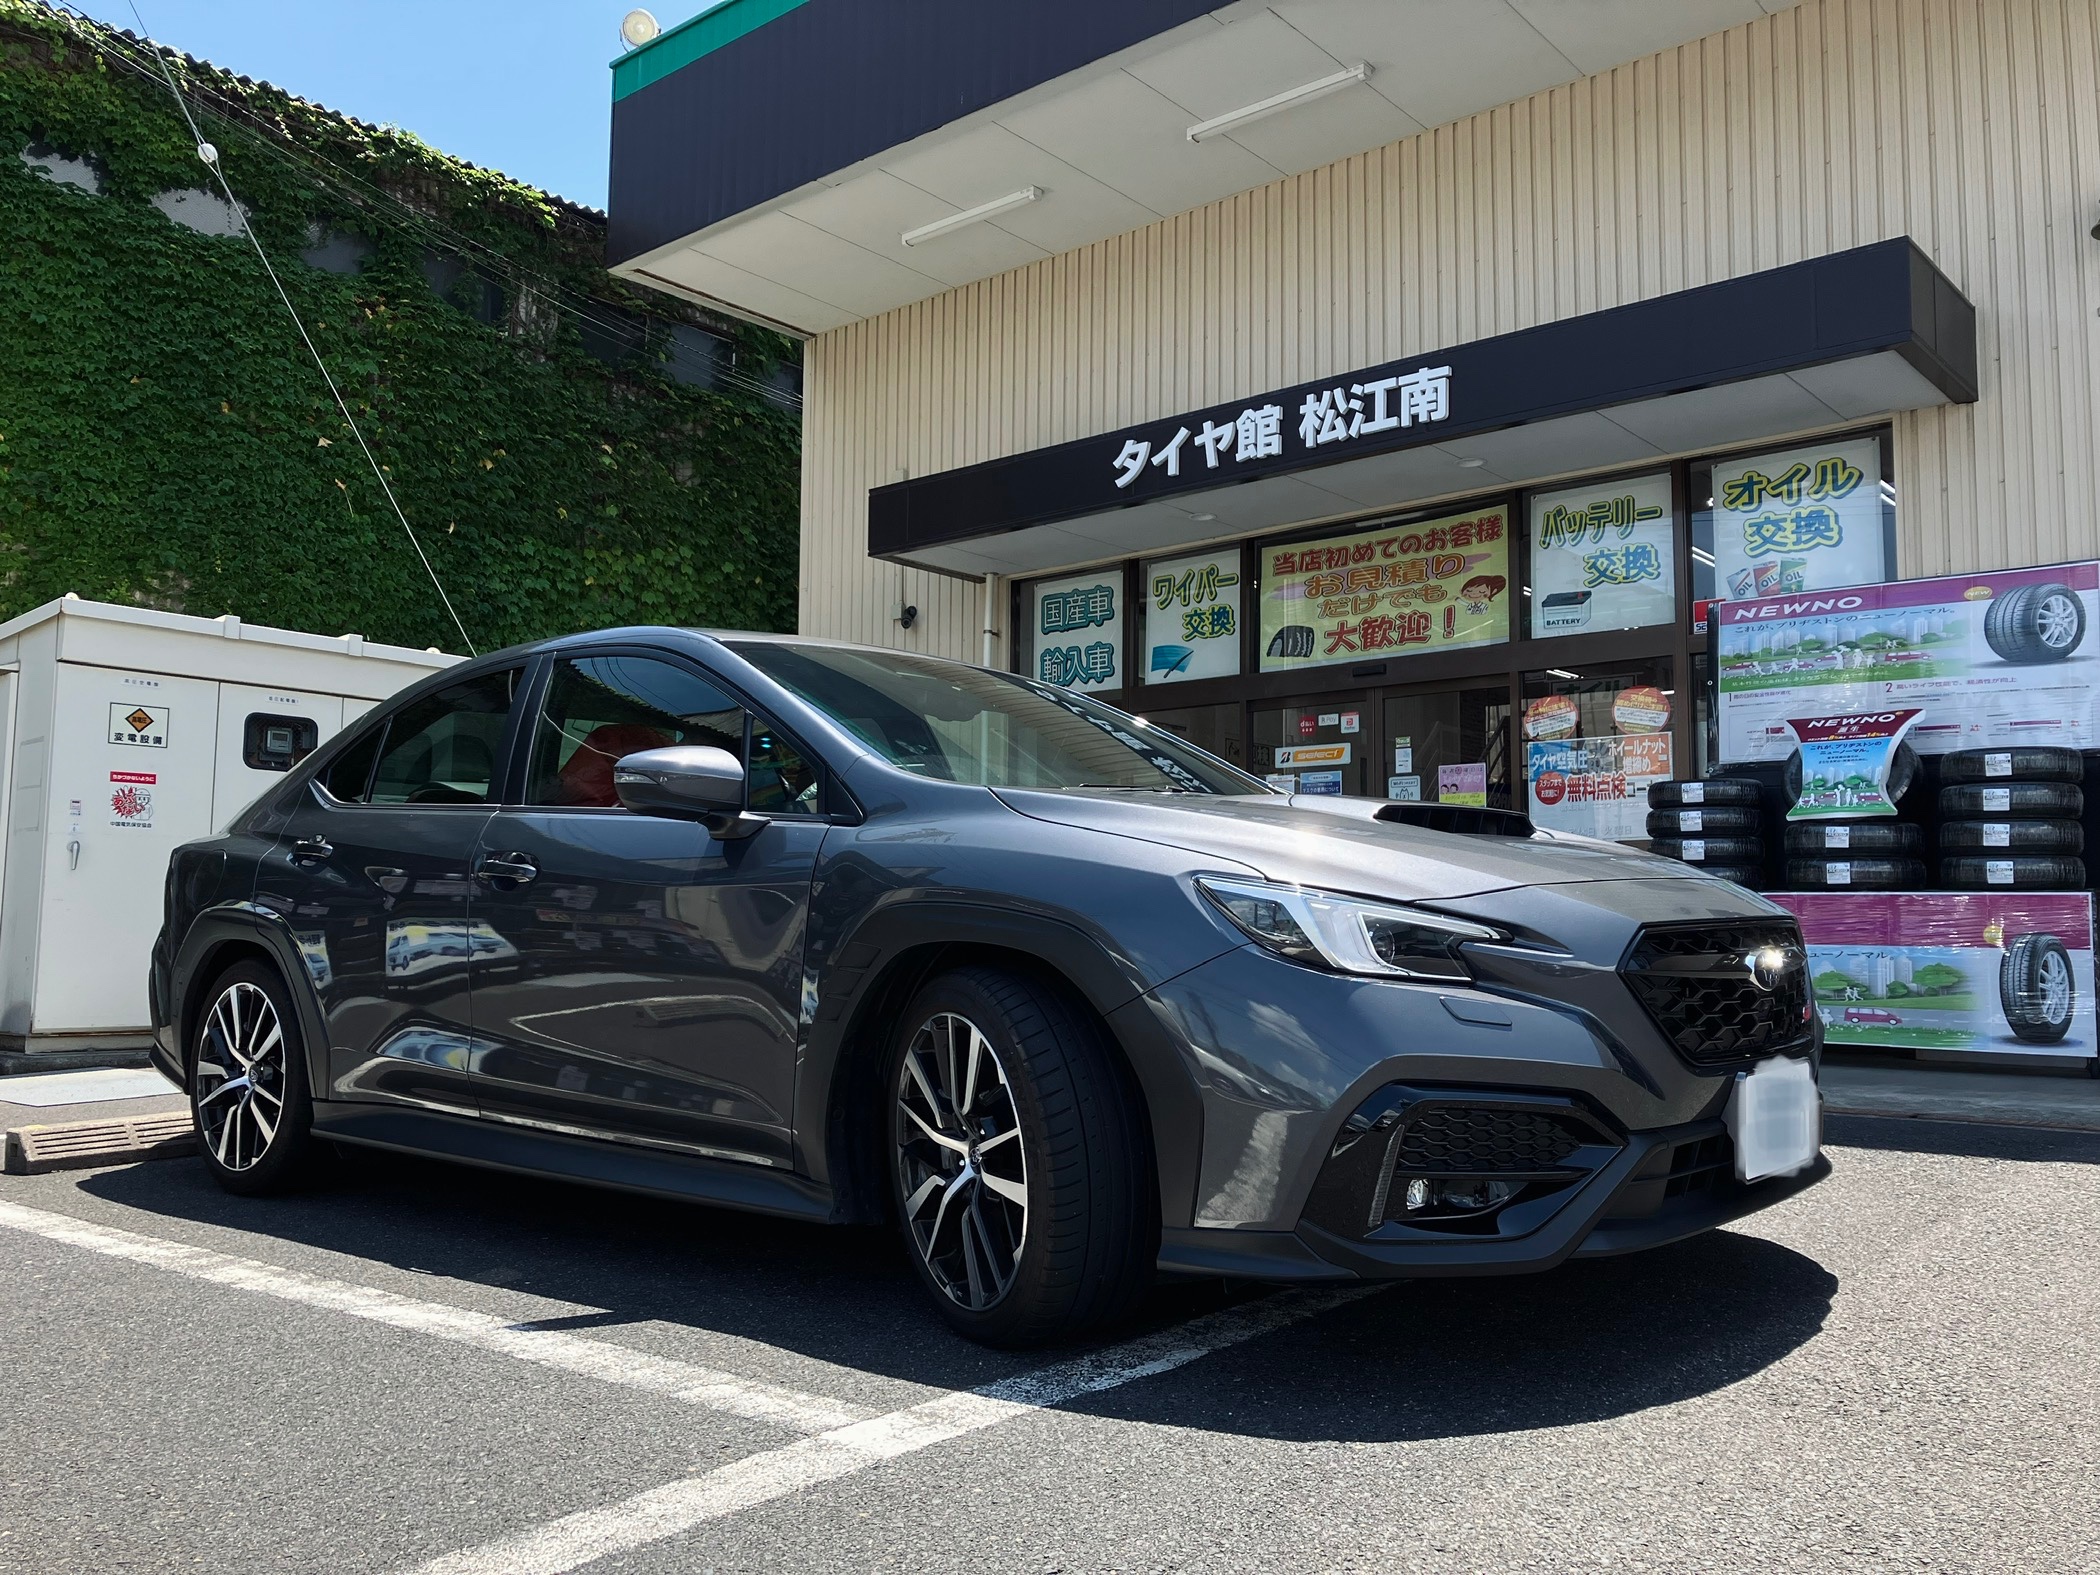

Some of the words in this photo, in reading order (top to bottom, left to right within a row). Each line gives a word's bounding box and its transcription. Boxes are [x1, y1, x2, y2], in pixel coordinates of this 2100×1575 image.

[1112, 404, 1283, 488] タイヤ館
[1299, 366, 1453, 448] 松江南
[1724, 457, 1863, 510] オイル
[1539, 496, 1662, 549] バッテリー
[1744, 505, 1843, 557] 交換
[1272, 514, 1504, 577] 当店初めてのお客様
[1304, 554, 1466, 597] お見積り
[1583, 544, 1660, 587] 交換
[1761, 575, 1777, 588] OIL
[1786, 571, 1804, 582] OIL
[1152, 564, 1239, 609] ワイパー
[1317, 584, 1449, 619] だけでも
[1738, 581, 1753, 596] OIL
[1040, 585, 1115, 634] 国産車
[1182, 603, 1235, 641] 交換
[1545, 617, 1581, 628] BATTERY
[1734, 596, 1863, 621] NEWNO
[1040, 640, 1115, 690] 輸入車
[1885, 682, 1893, 693] 2
[1807, 713, 1896, 728] NEWNO
[114, 732, 162, 745] 変電設備
[1608, 738, 1666, 757] ホイールナット
[1531, 750, 1588, 772] タイヤ空気圧
[1623, 756, 1651, 776] 増締め
[1567, 772, 1652, 802] 無料点検コー
